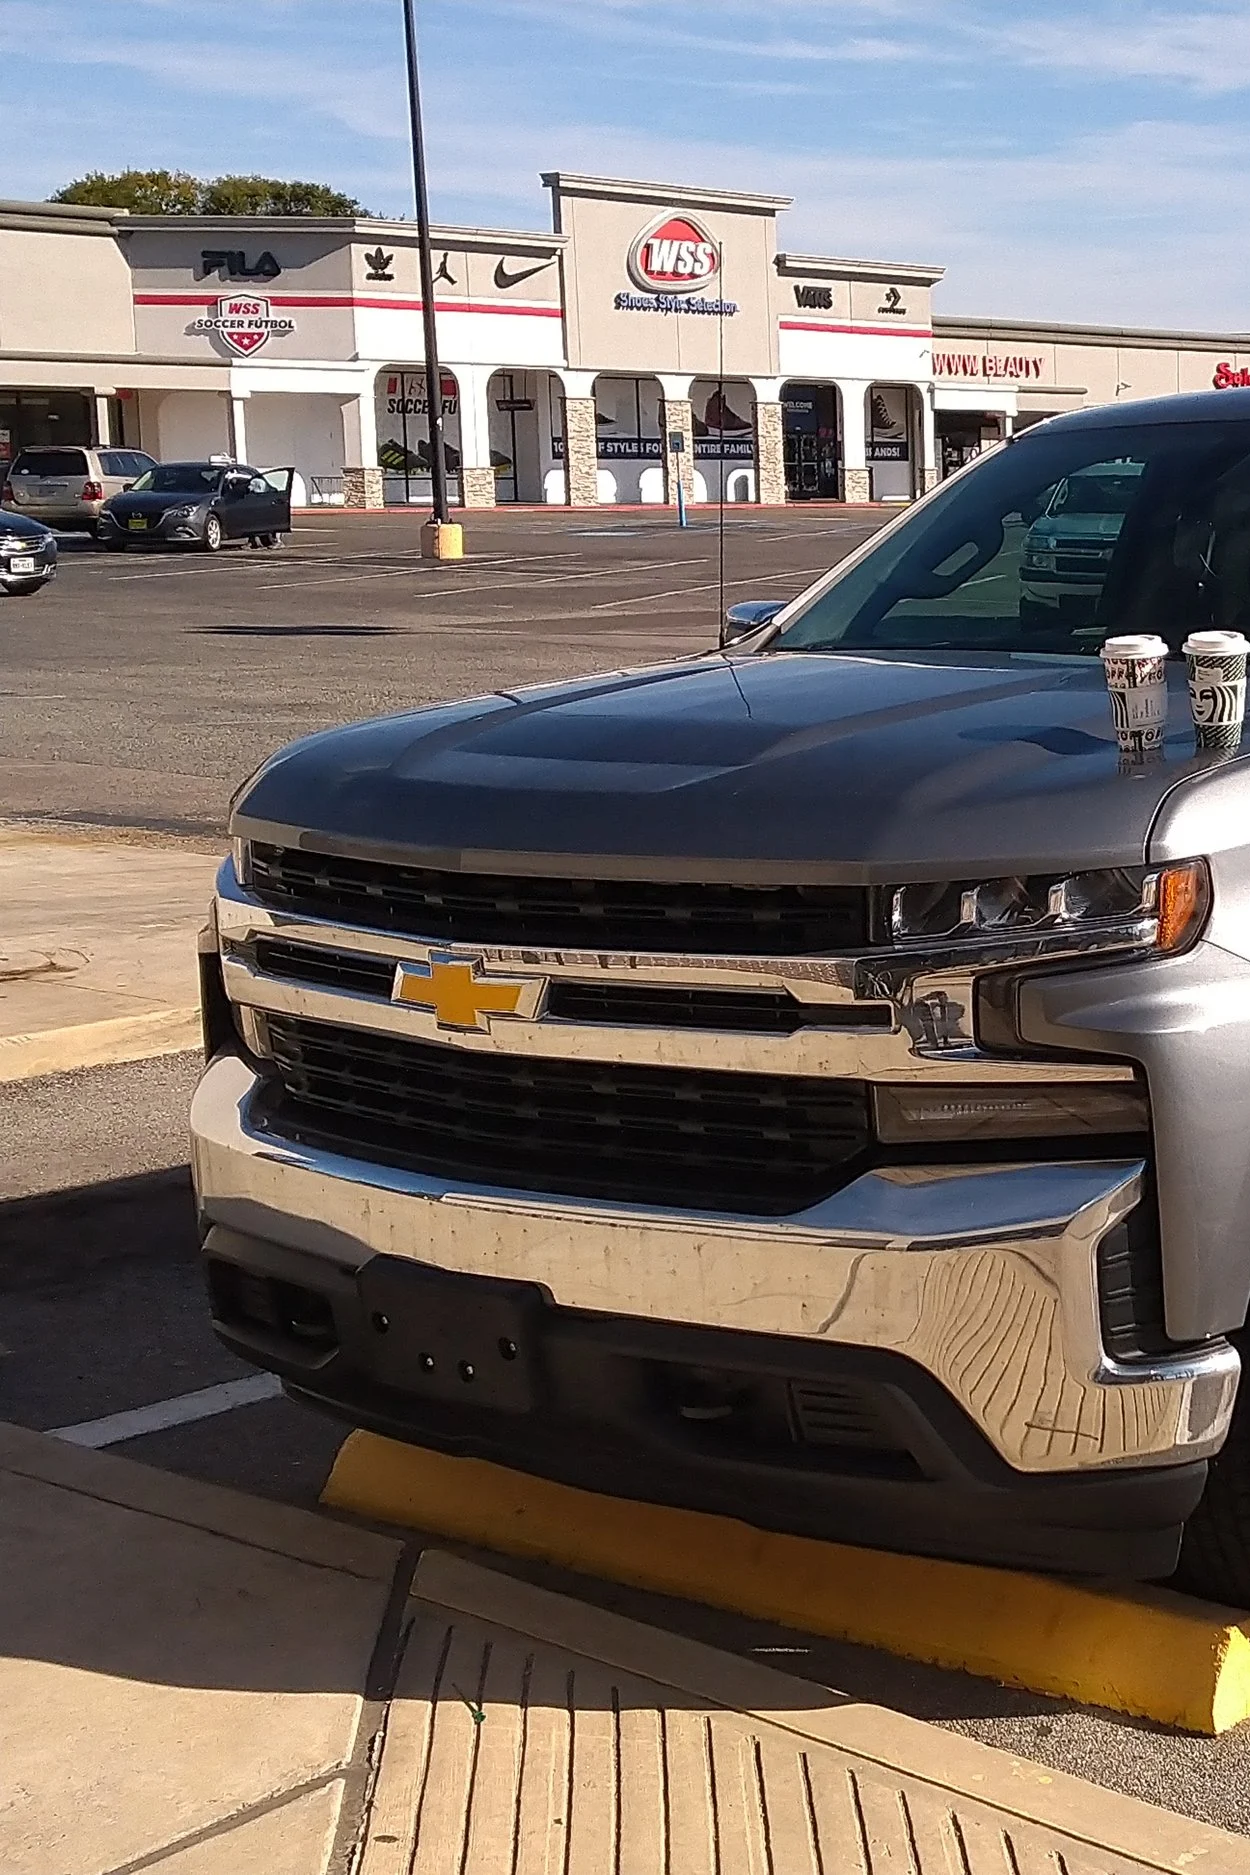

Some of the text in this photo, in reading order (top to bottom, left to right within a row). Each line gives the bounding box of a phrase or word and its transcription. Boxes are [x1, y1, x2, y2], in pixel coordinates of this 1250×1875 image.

[201, 250, 282, 276] FILA
[647, 238, 713, 275] WSS
[228, 302, 260, 315] WSS
[196, 319, 244, 329] SOCCER
[982, 355, 1044, 378] BEAUTY
[387, 398, 457, 414] SOCCE FU
[694, 443, 721, 454] NTIRE
